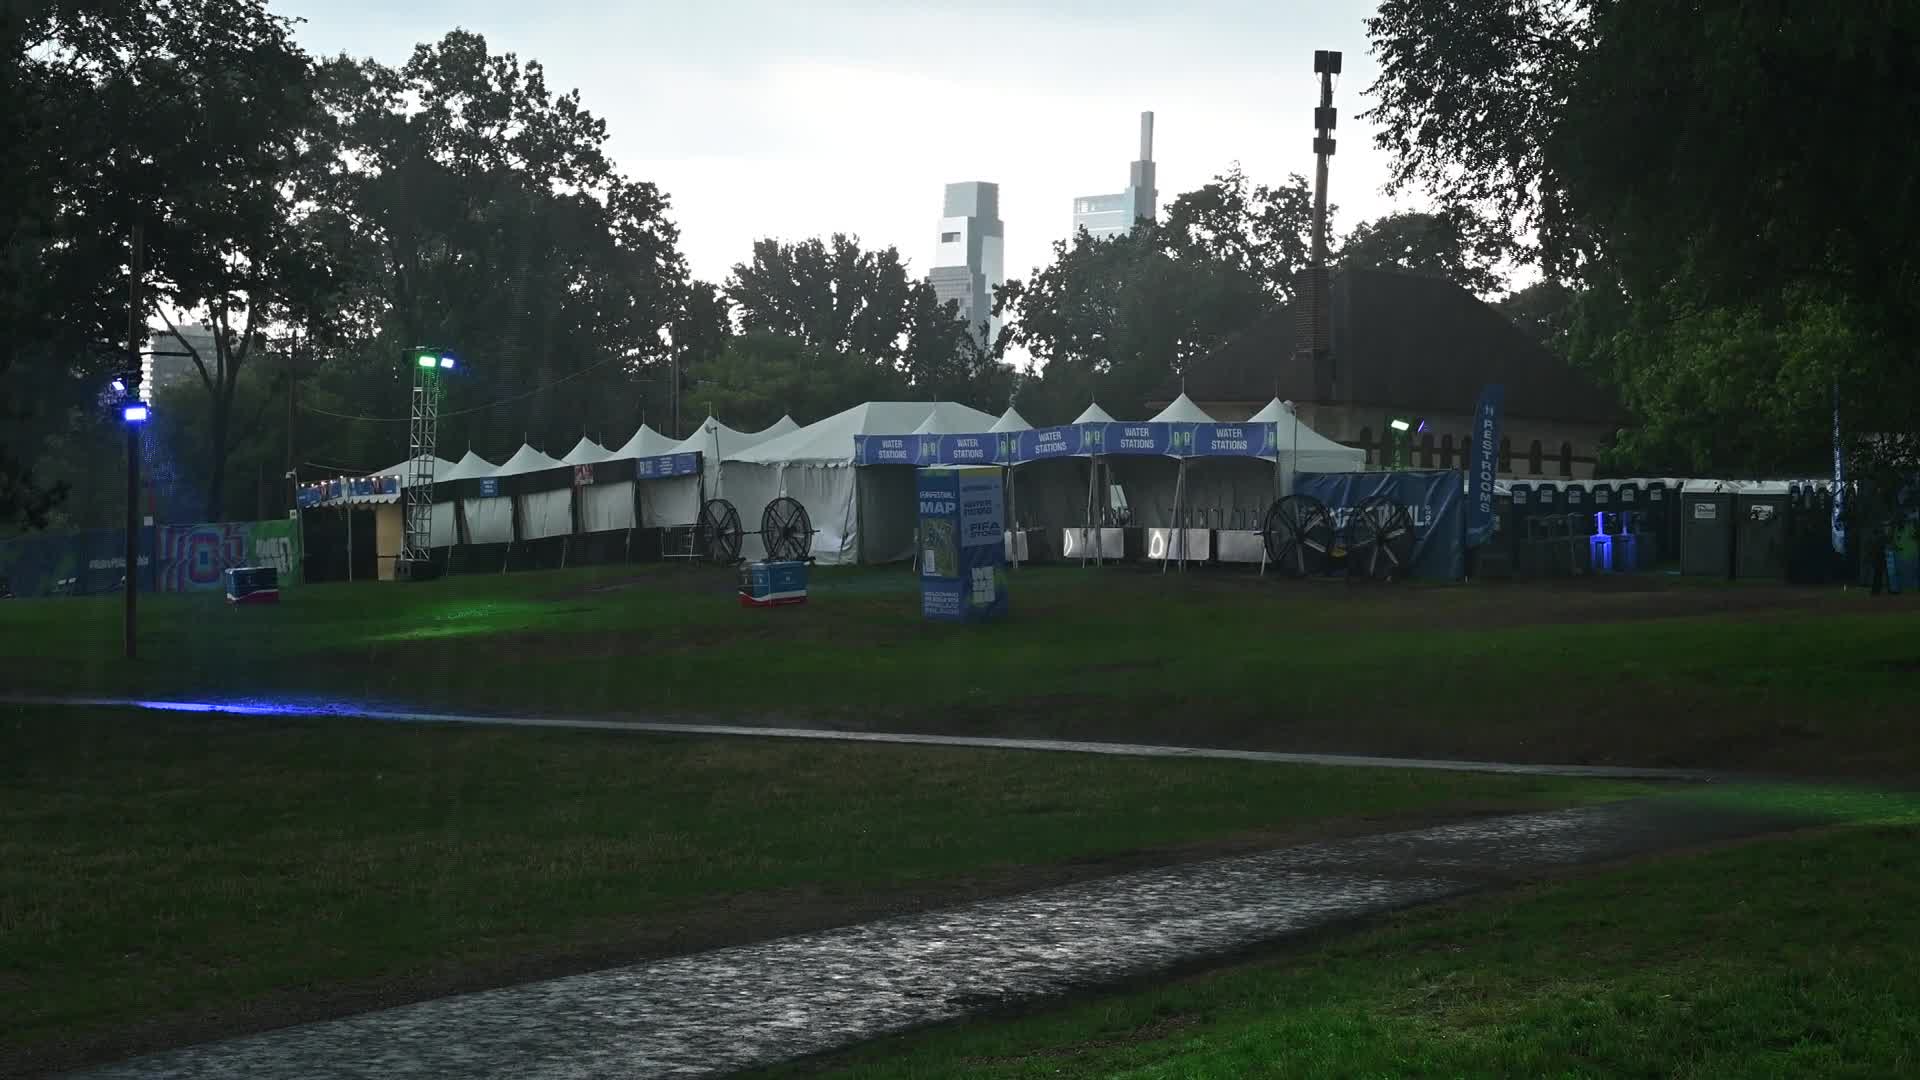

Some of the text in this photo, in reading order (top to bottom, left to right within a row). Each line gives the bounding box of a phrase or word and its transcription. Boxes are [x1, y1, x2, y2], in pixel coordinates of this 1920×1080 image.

[1038, 431, 1062, 443] WATER
[1125, 427, 1150, 437] WATER
[1216, 428, 1243, 438] WATER
[881, 440, 903, 448] WATER
[957, 439, 979, 447] WATER
[1035, 441, 1068, 454] STATIONS
[1120, 439, 1155, 449] STATIONS
[1211, 440, 1248, 450] STATIONS
[878, 450, 907, 459] STATIONS
[953, 449, 984, 459] STATIONS
[1480, 419, 1494, 512] RESTROOMS
[920, 501, 956, 513] MAP
[970, 521, 1001, 531] FIFA
